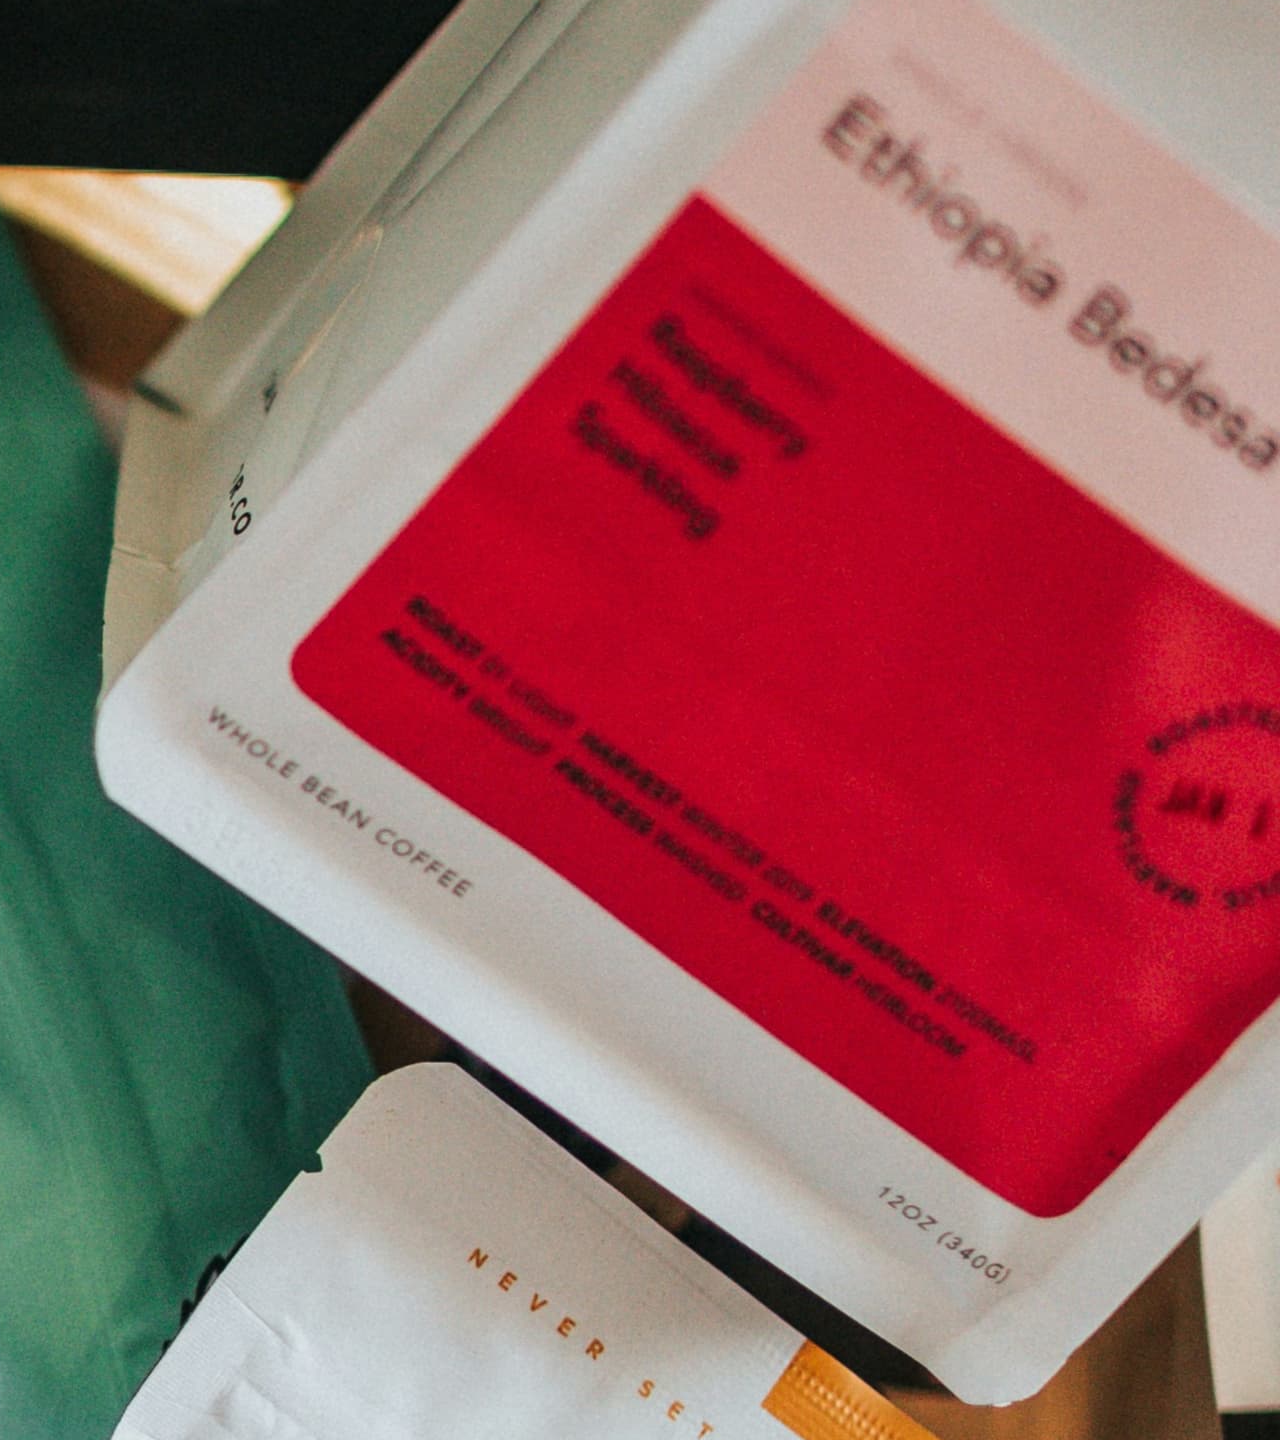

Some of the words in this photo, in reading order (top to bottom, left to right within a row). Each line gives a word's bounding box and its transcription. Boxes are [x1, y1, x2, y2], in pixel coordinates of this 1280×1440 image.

[820, 91, 1068, 312] Ethiopia
[1068, 282, 1280, 472] Bedesa
[206, 705, 295, 777] WHOLE
[300, 771, 373, 834] BEAN
[373, 826, 475, 901] COFFEE
[465, 1244, 607, 1362] NEVER
[936, 1224, 1014, 1289] (340G)
